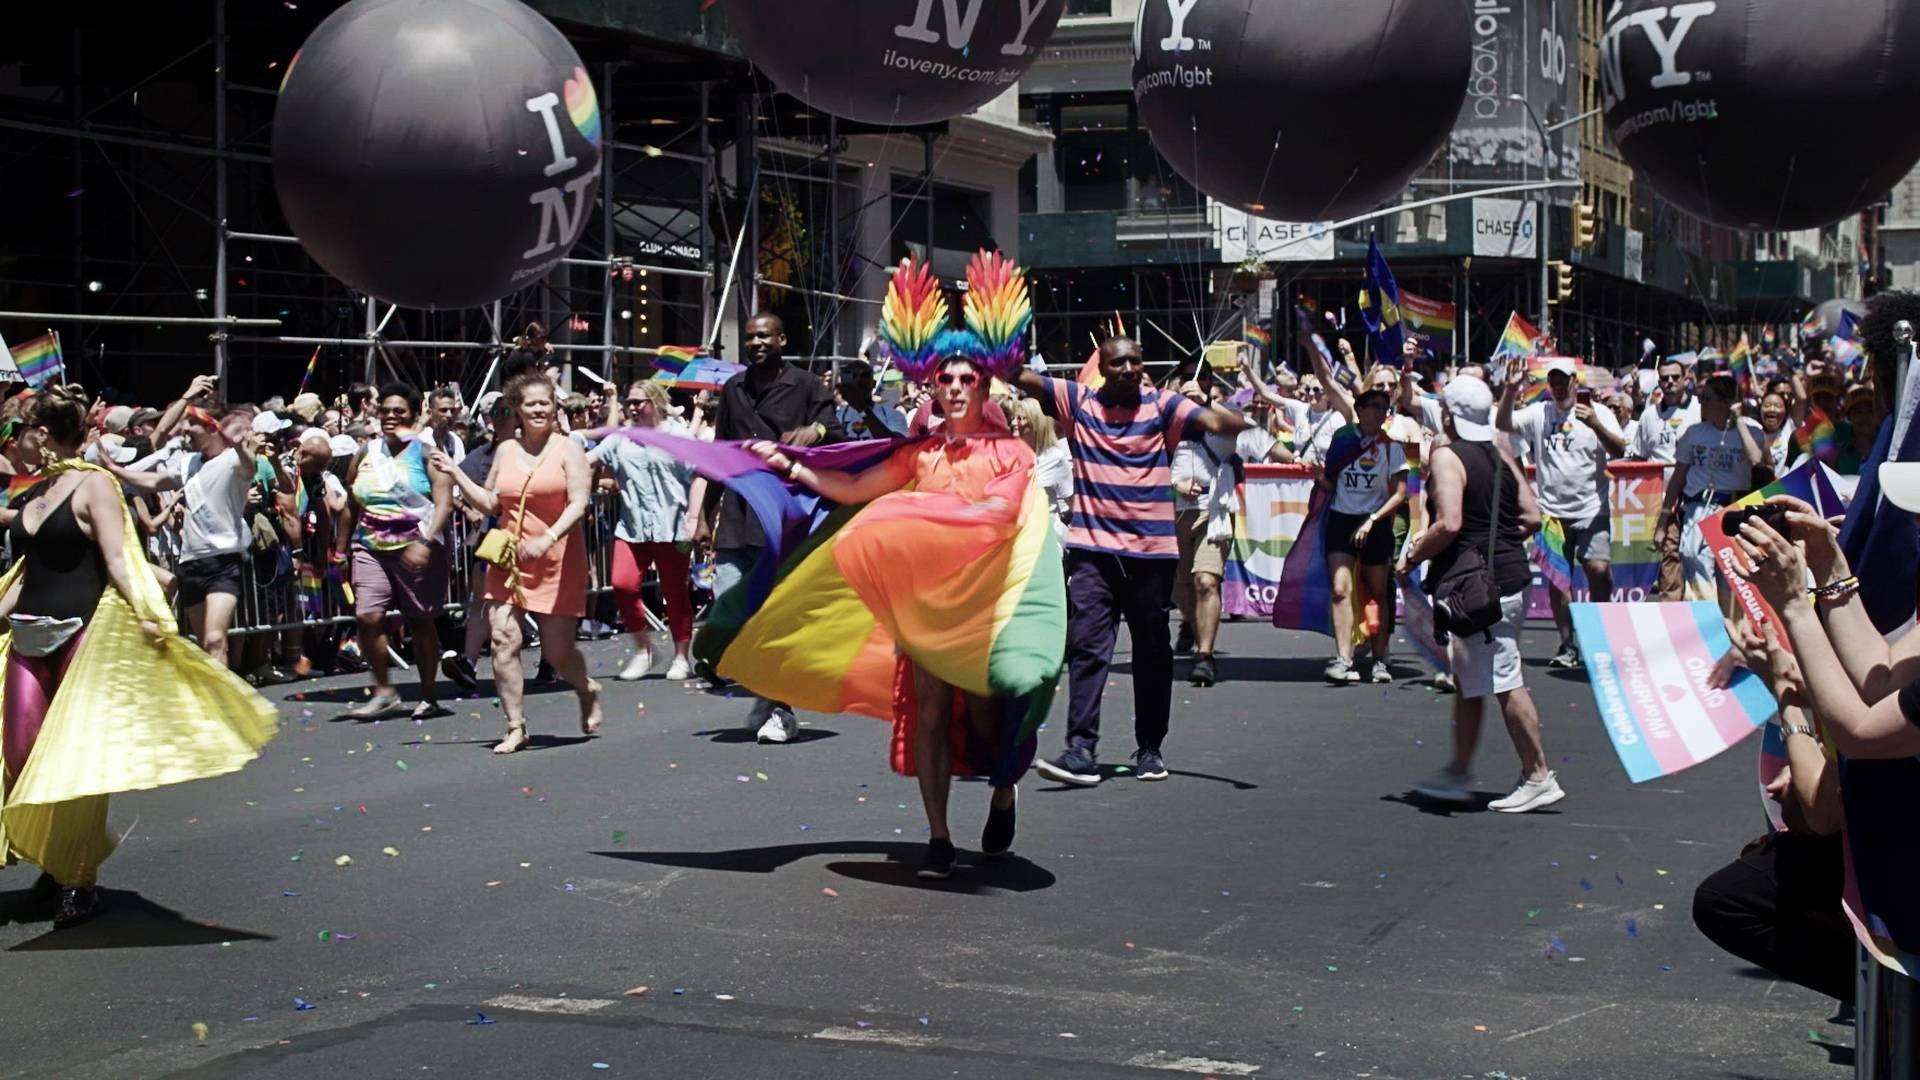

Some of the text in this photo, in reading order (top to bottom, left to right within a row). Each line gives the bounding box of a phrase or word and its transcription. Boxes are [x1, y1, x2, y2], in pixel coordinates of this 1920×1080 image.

[526, 92, 578, 177] I
[1476, 218, 1519, 237] CHASE
[1659, 431, 1677, 445] N
[1345, 473, 1378, 489] NY
[1245, 584, 1280, 604] GO
[1593, 651, 1639, 746] Celebrating
[1620, 646, 1673, 740] #WorldPride
